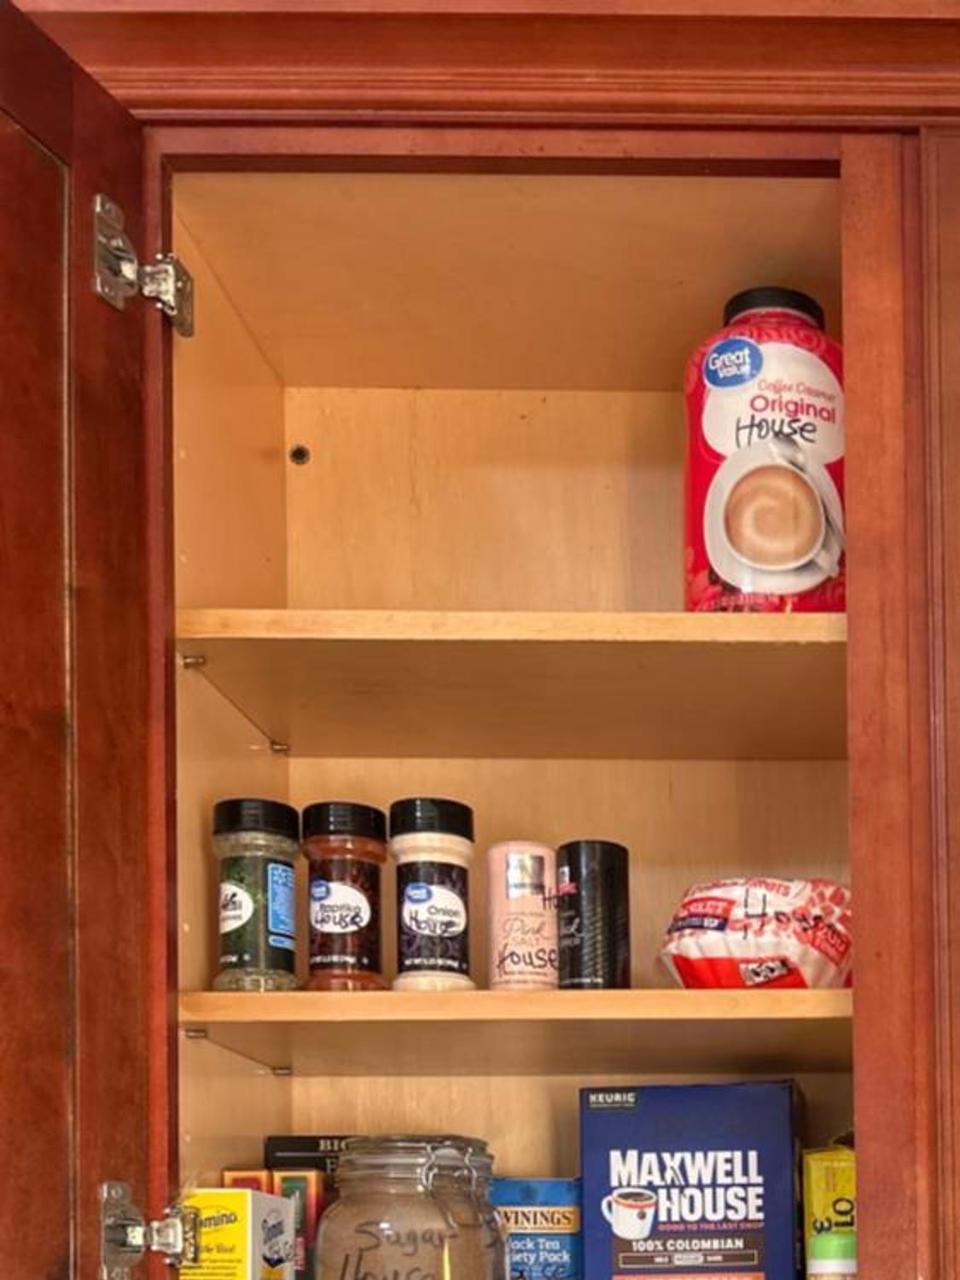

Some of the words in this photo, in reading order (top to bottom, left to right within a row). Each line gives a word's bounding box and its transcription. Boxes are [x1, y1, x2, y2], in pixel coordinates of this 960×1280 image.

[709, 347, 751, 370] Great
[750, 395, 836, 423] Original
[735, 414, 818, 448] House
[427, 905, 462, 918] Onion
[496, 943, 558, 978] House
[589, 1092, 636, 1103] KEURIG
[610, 1149, 764, 1187] MAXWELL
[657, 1187, 765, 1222] HOUSE
[354, 1221, 459, 1256] Sugar
[538, 1238, 561, 1249] Tea
[632, 1240, 664, 1252] 100%
[666, 1238, 744, 1251] COLOMBIAN
[539, 1250, 571, 1262] Pack
